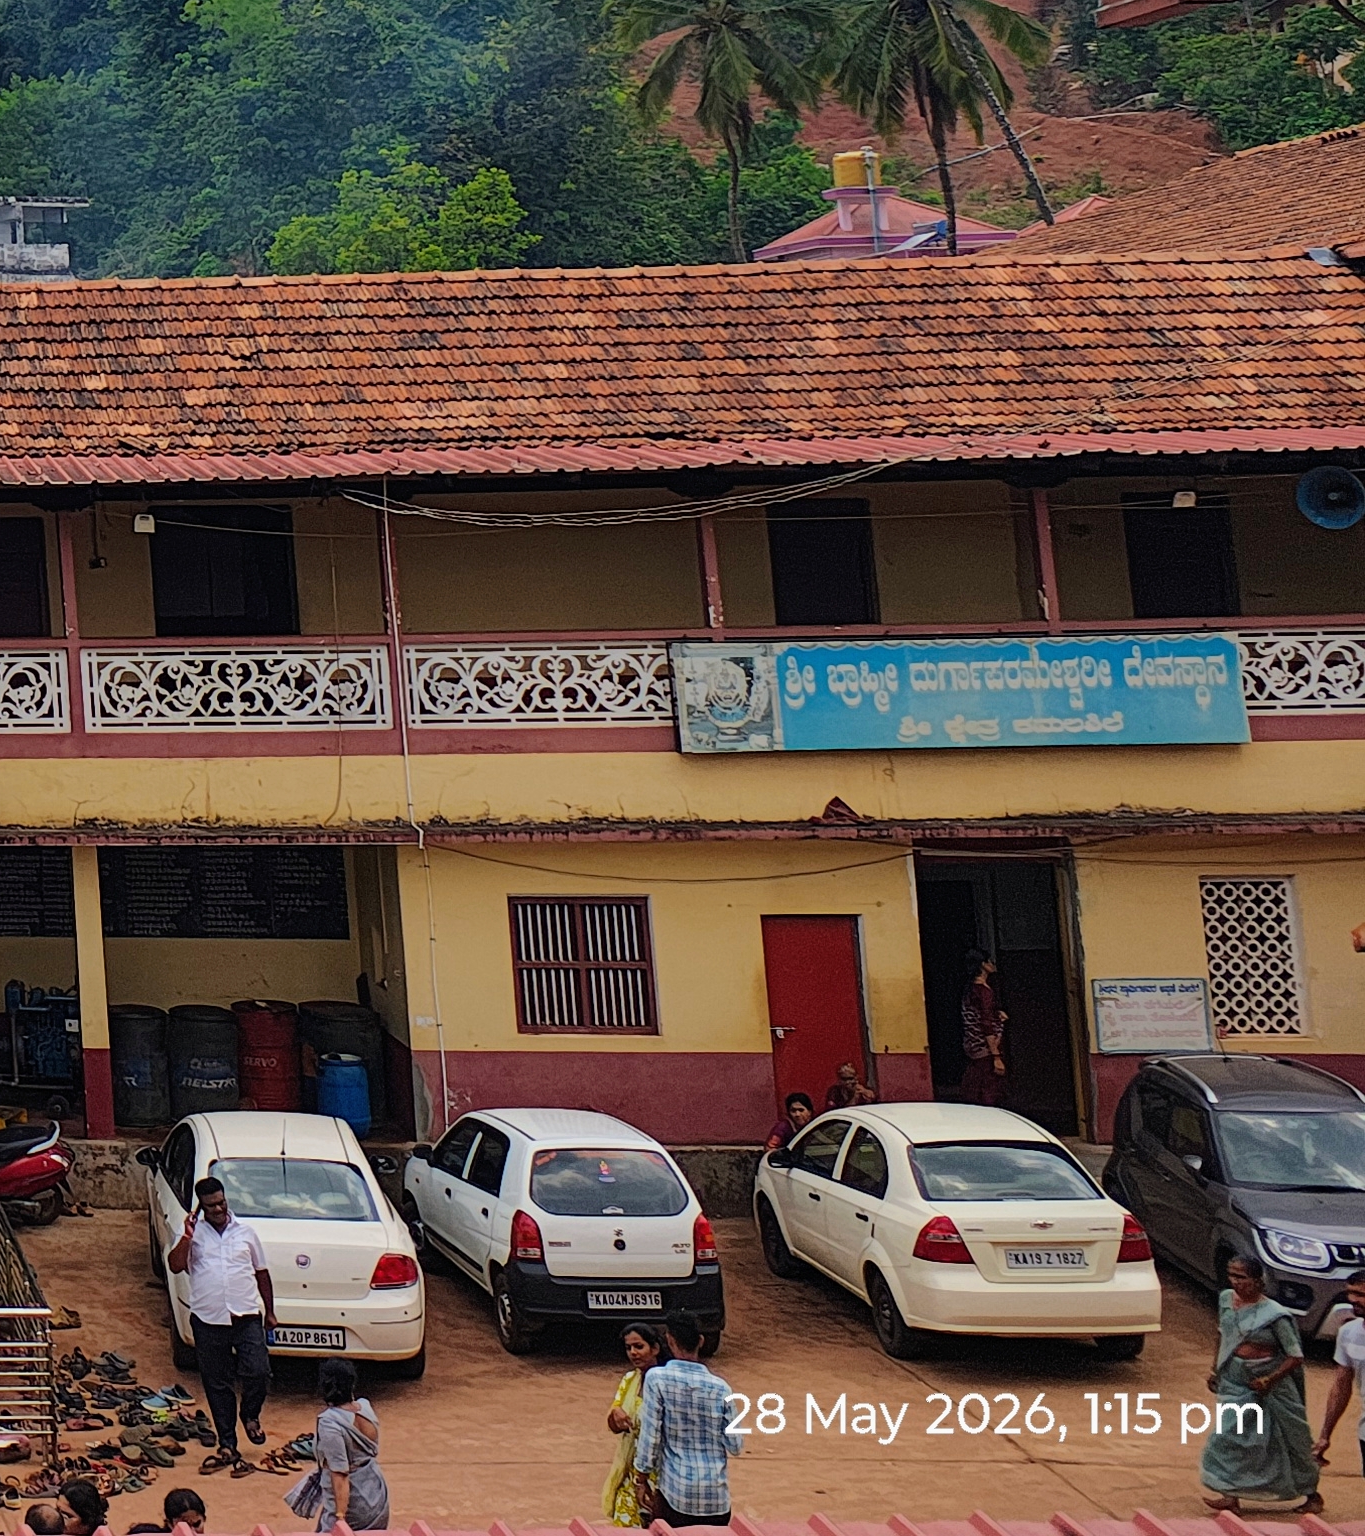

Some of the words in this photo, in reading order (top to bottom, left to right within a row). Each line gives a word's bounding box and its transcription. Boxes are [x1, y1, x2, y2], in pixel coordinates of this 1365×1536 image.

[784, 655, 816, 709] ಶ್ರೀ
[1123, 645, 1227, 711] ದೇವಸ್ಥಾನ
[897, 716, 931, 743] ಶ್ರೀ
[243, 1056, 277, 1068] SERVO
